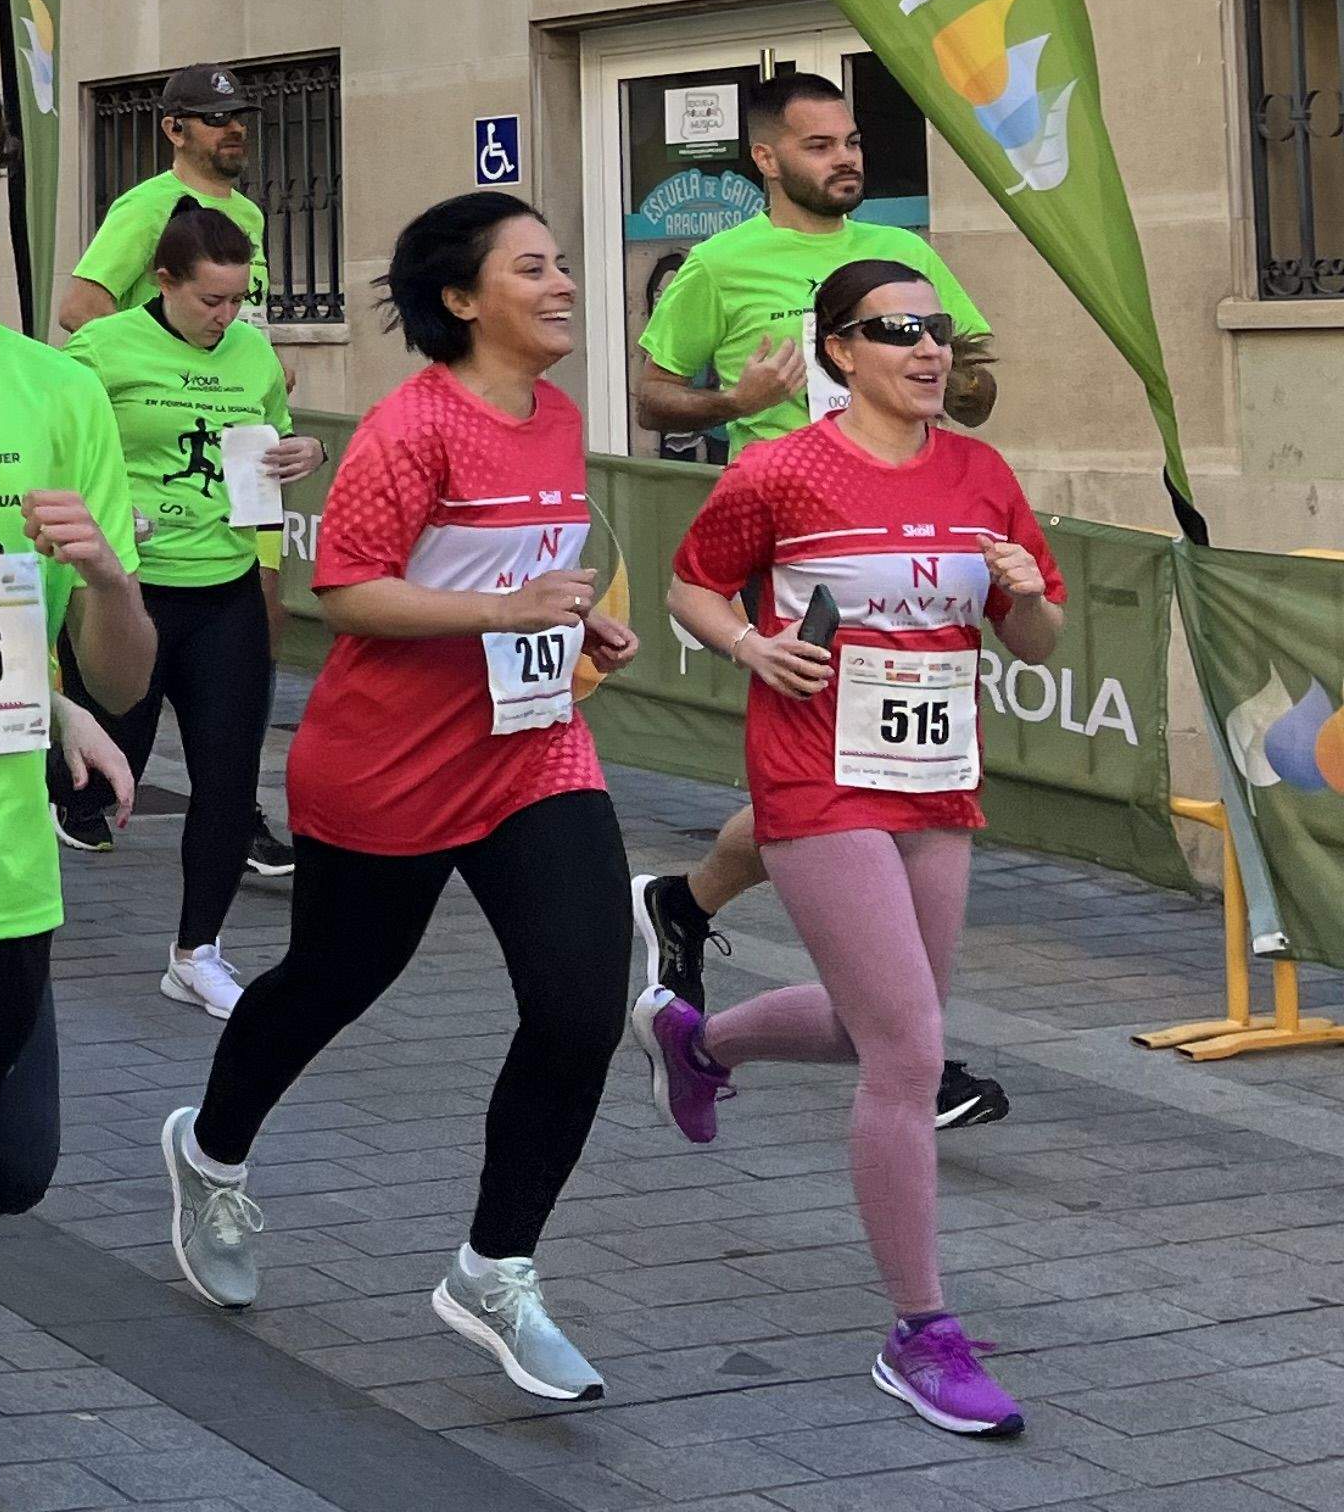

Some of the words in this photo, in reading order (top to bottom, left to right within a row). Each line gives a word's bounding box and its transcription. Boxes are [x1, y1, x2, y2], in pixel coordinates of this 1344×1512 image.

[643, 173, 701, 225] ESCUELA
[515, 633, 565, 683] 247
[880, 698, 950, 746] 515
